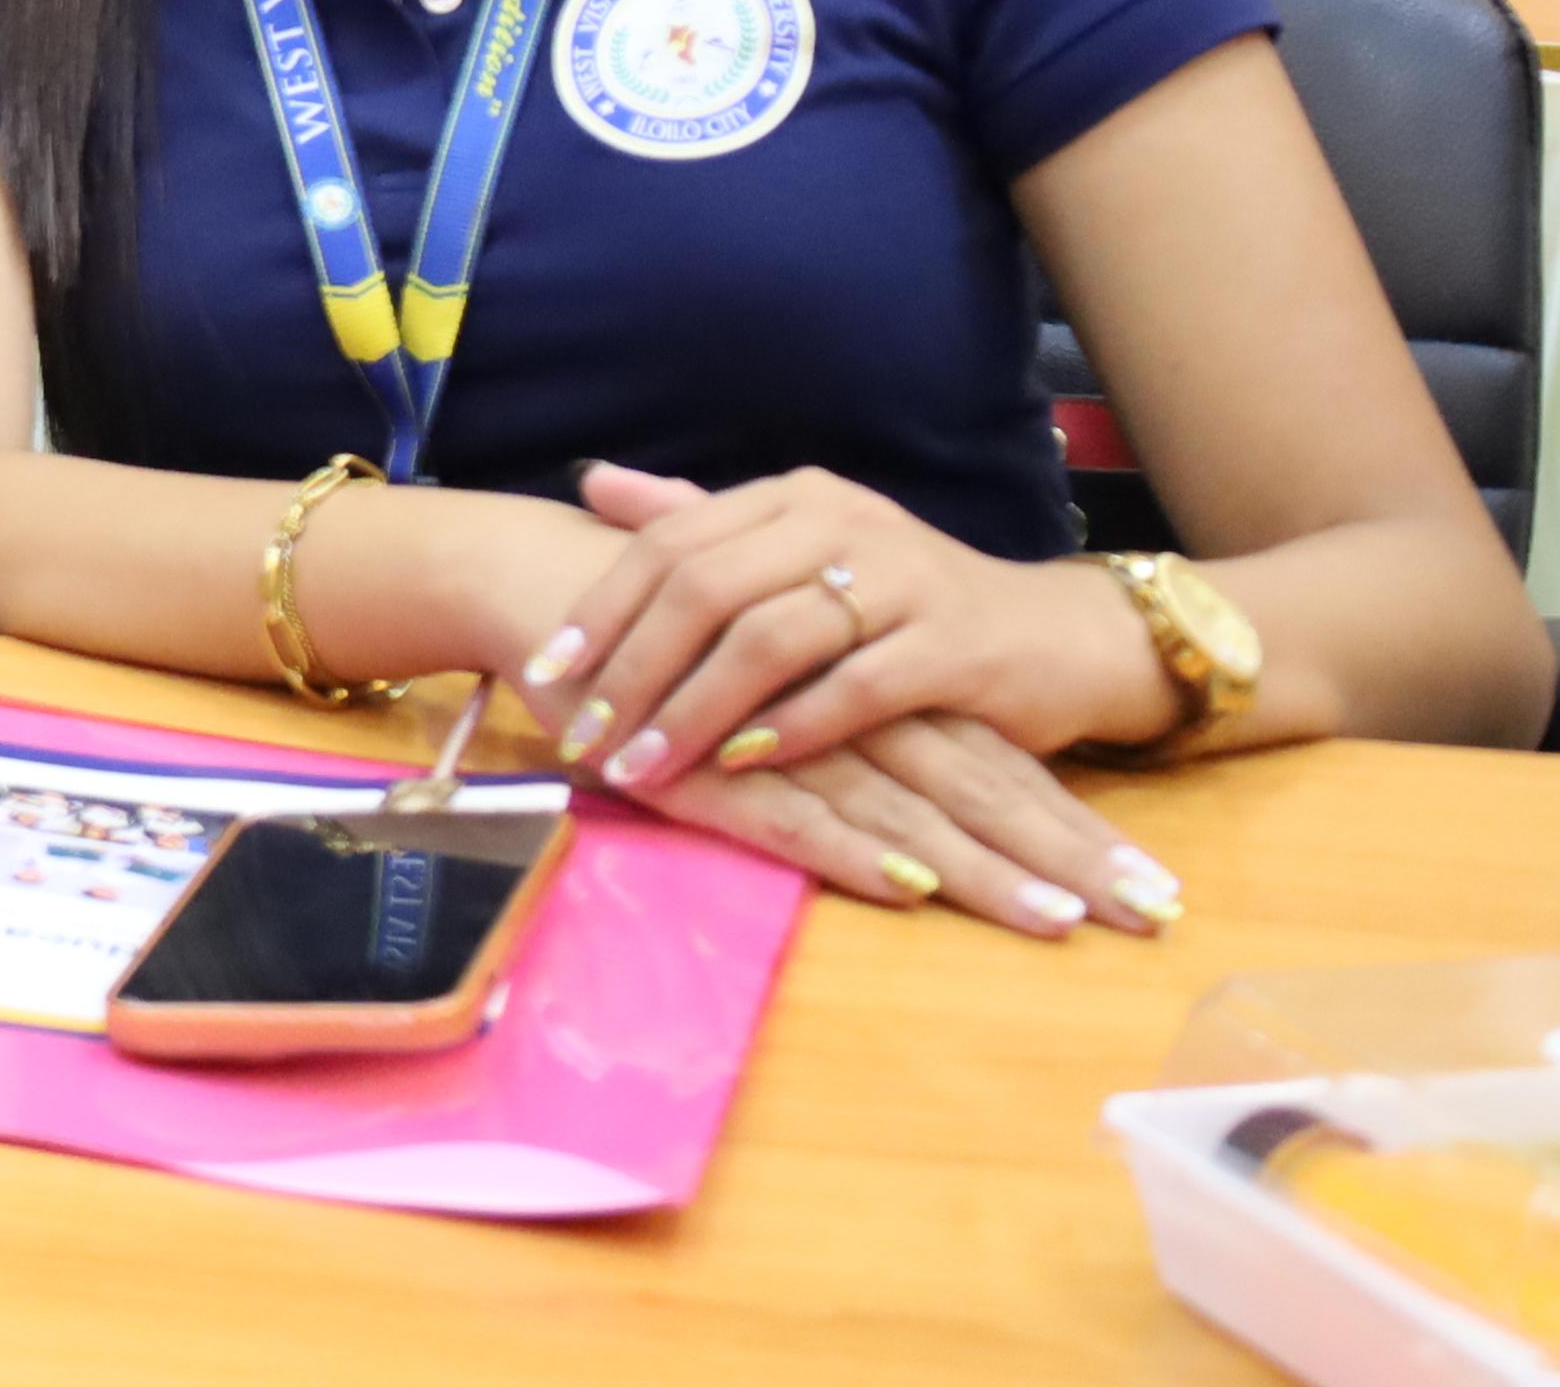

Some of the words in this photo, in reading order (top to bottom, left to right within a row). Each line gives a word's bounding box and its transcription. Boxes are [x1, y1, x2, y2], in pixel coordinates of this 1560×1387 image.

[268, 23, 332, 146] WEST
[575, 46, 605, 101] WEST
[630, 116, 702, 141] ILOILO
[706, 101, 753, 135] CITY
